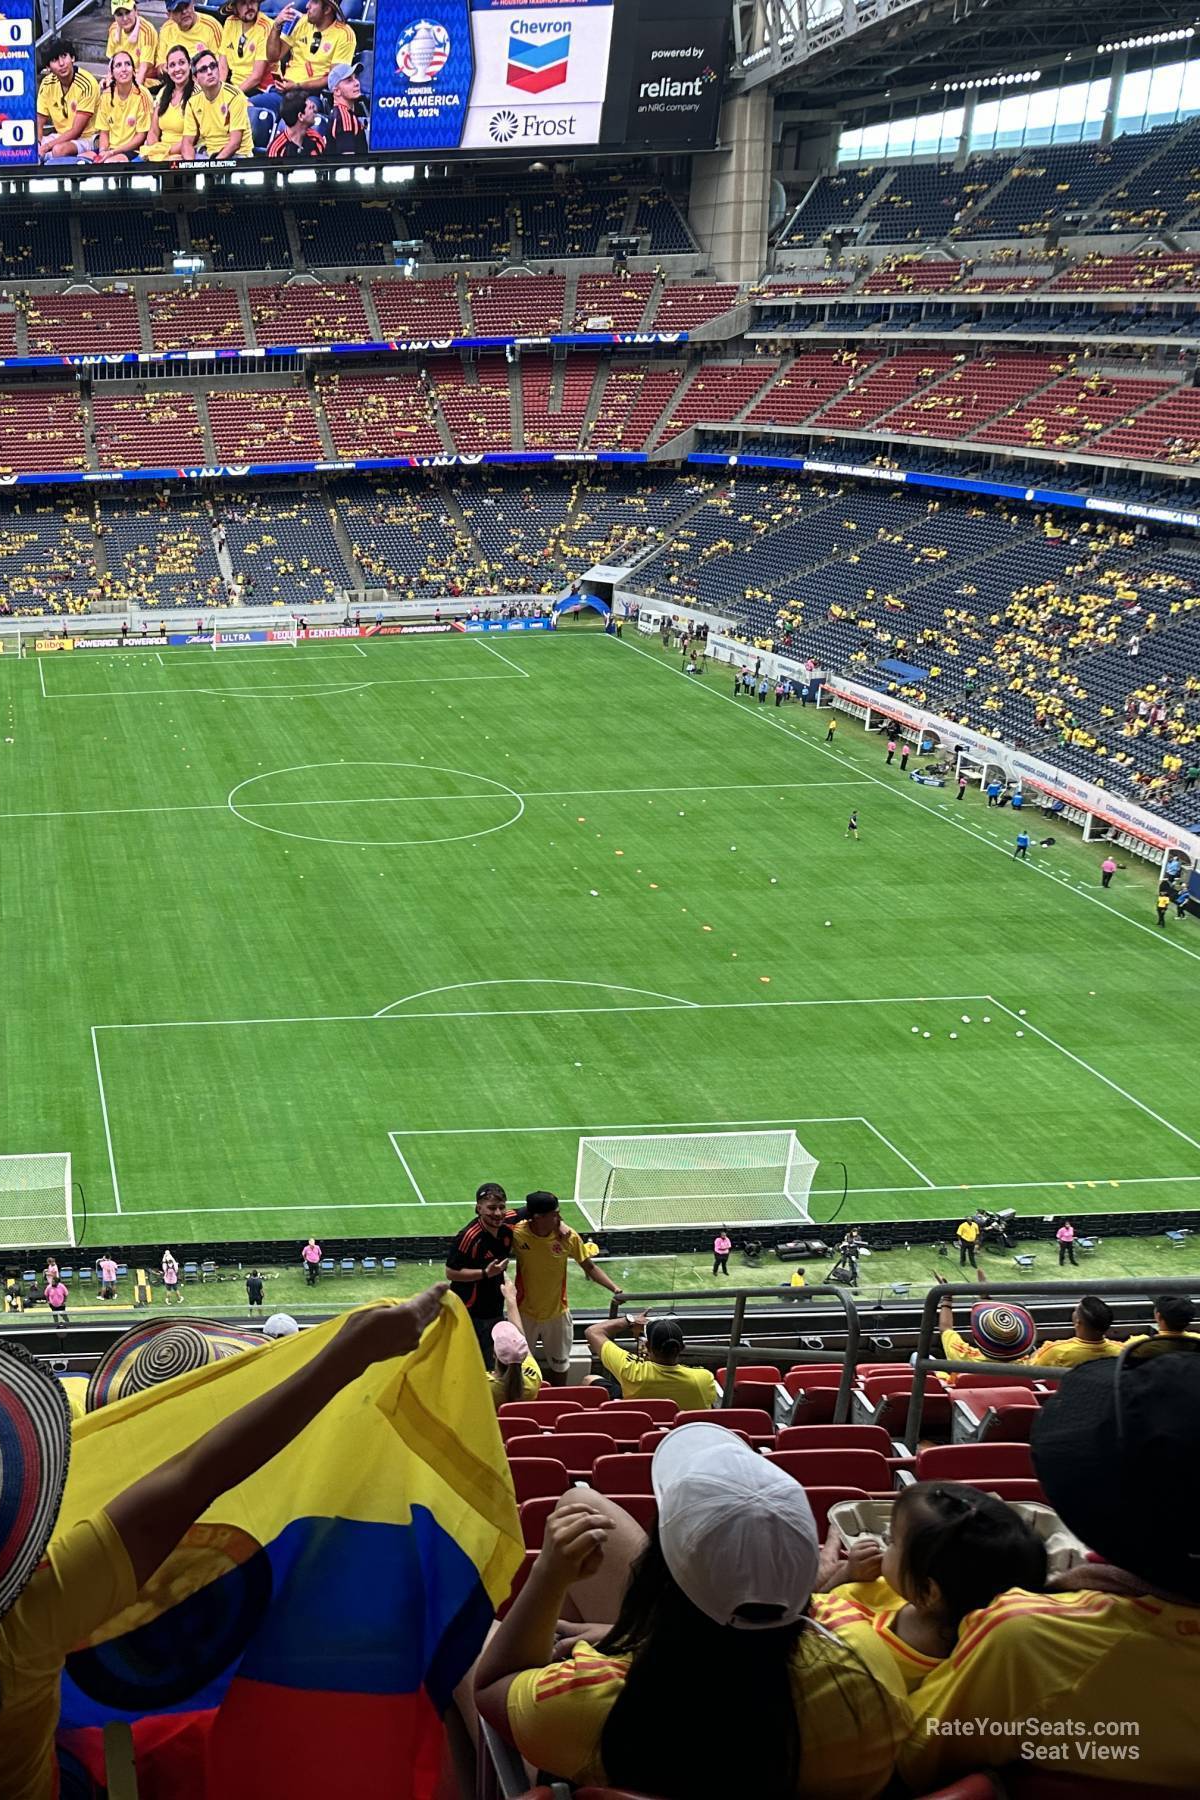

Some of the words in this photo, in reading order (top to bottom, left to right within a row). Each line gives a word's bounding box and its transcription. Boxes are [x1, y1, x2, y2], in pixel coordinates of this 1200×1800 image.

[10, 24, 21, 41] 0
[510, 20, 572, 34] Chevron
[651, 46, 691, 61] powered
[692, 47, 704, 59] by
[639, 77, 703, 98] reliant
[379, 96, 409, 108] COPA
[410, 94, 460, 107] AMERICA
[648, 103, 665, 112] NRG
[666, 103, 700, 112] company
[398, 109, 416, 118] USA
[417, 108, 440, 118] 2024
[522, 115, 576, 136] Frost
[13, 125, 24, 142] 0
[222, 633, 251, 642] ULTRA
[272, 630, 305, 640] TEQUILA
[309, 628, 360, 638] CENTENARIO
